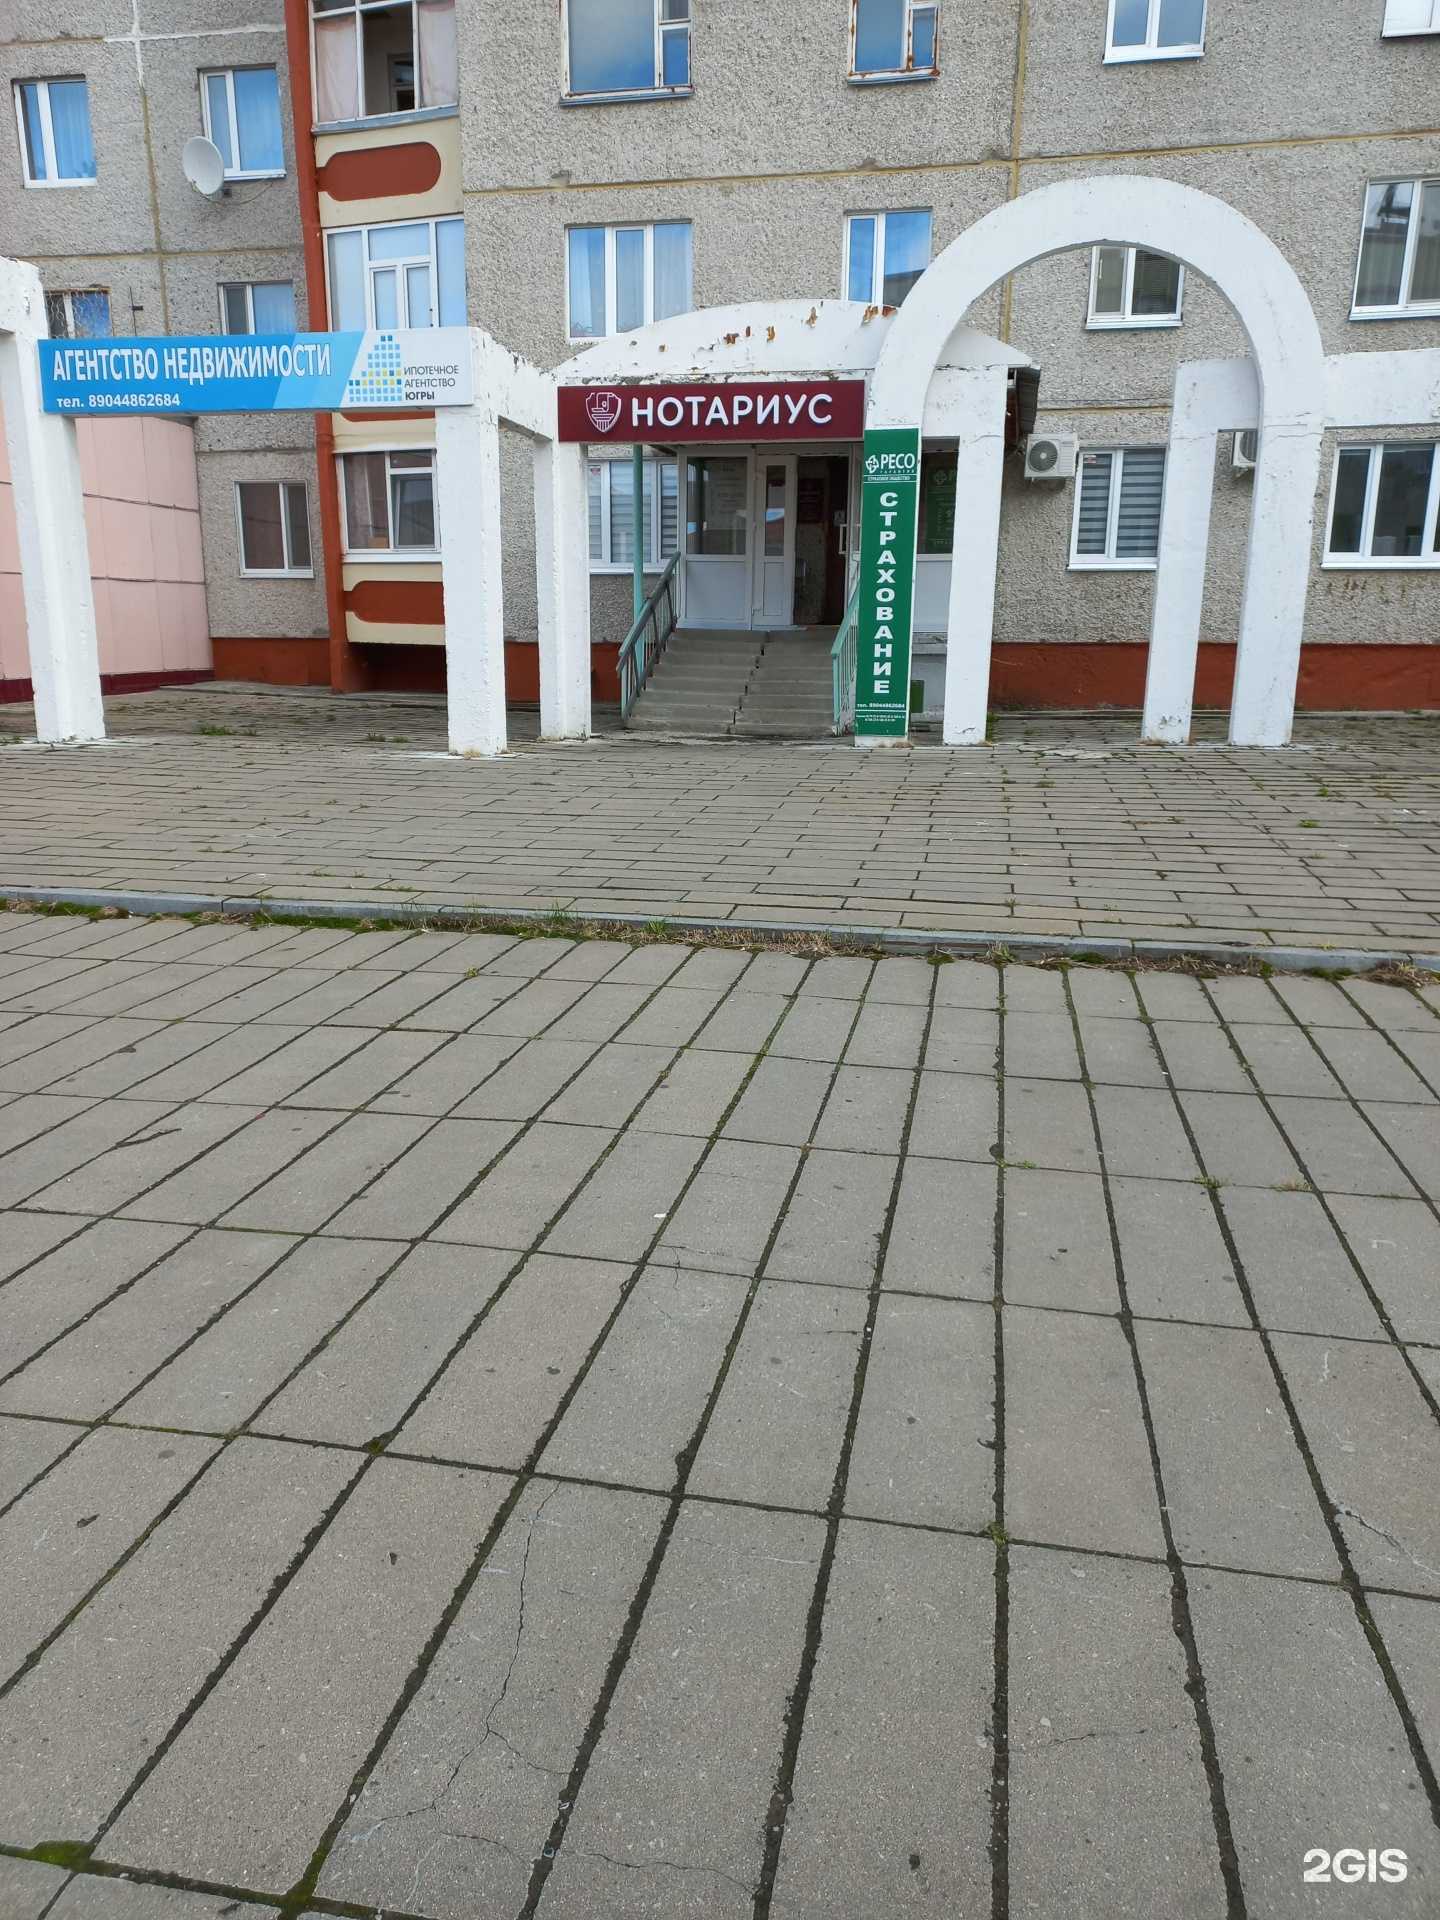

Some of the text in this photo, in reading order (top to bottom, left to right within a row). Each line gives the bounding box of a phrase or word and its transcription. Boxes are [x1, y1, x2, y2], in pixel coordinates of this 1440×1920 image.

[53, 344, 331, 386] АГЕНТСТВО НЕДВИЖИМОСТИ
[404, 365, 459, 375] ИПОТЕЧНОЕ
[405, 378, 456, 387] АГЕНТСТВО
[57, 393, 181, 408] тел. 89044862684
[405, 391, 435, 400] ЮГРЫ
[632, 393, 833, 427] НОТАРИУС
[880, 453, 916, 469] РЕСО
[873, 492, 898, 694] СТРАХОВАНИЕ
